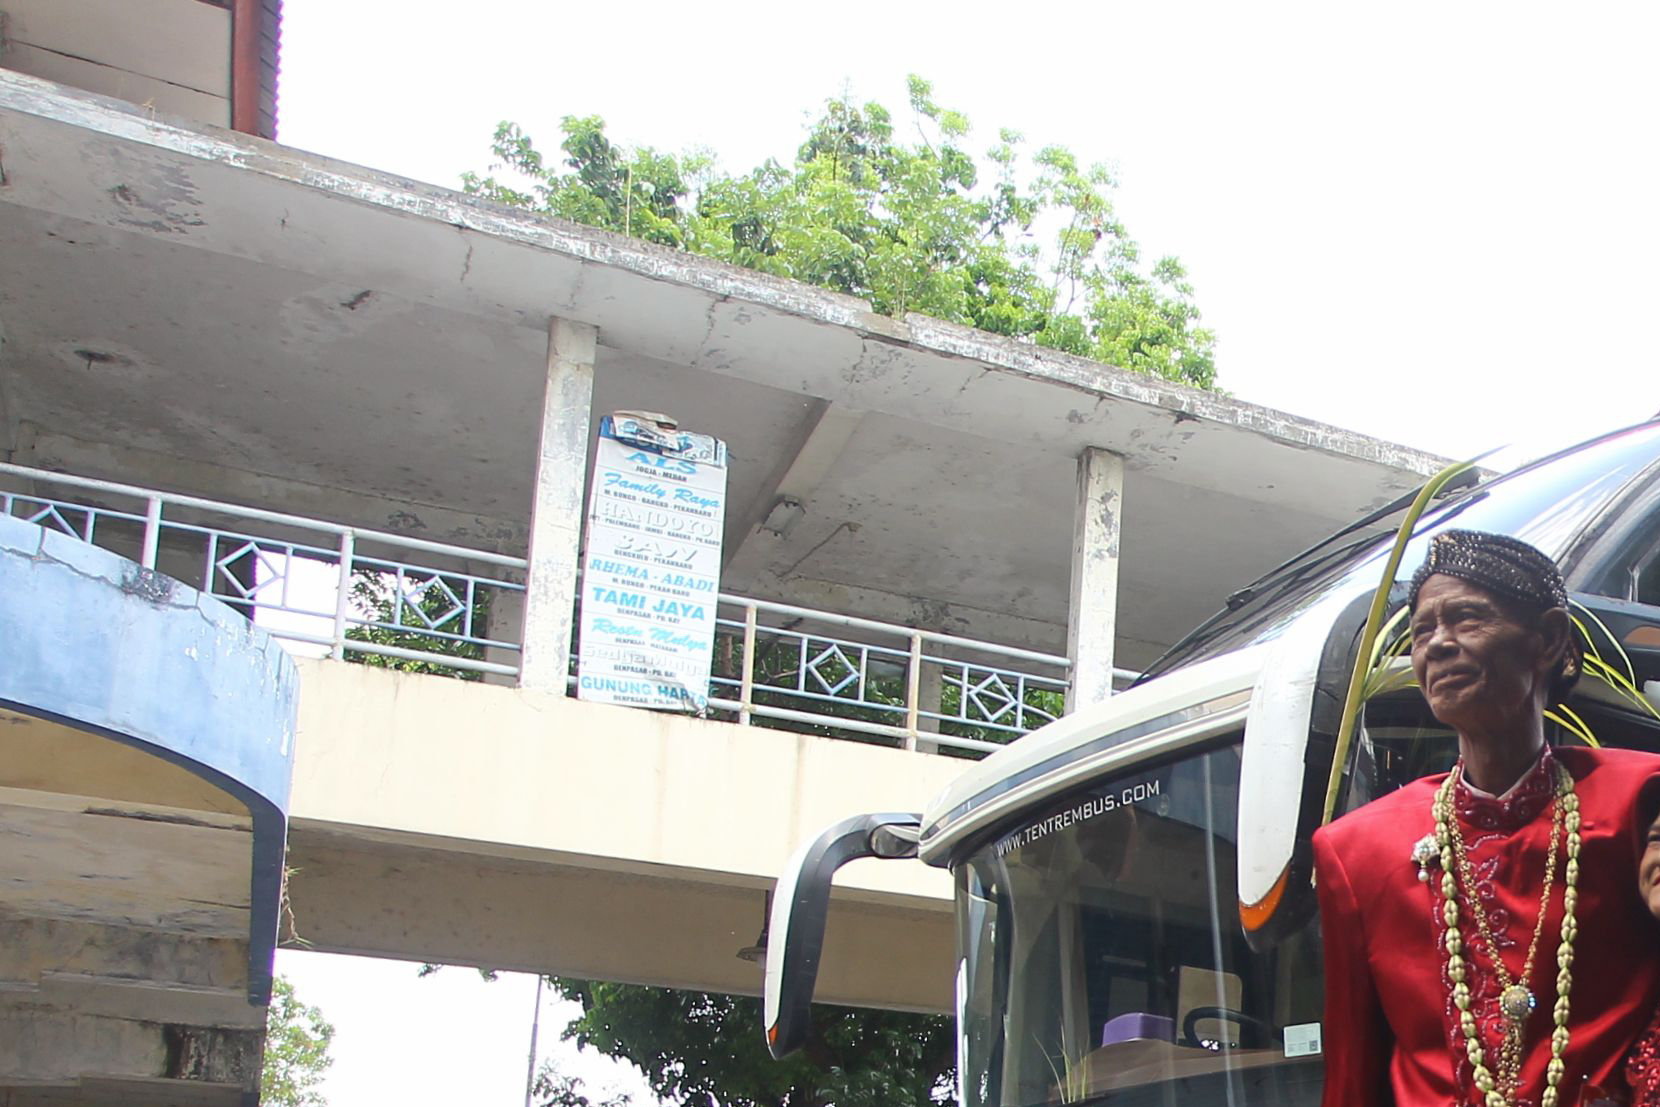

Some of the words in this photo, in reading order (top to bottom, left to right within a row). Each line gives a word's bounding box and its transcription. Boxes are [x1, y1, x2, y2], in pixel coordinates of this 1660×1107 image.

[626, 451, 697, 475] ALS
[604, 471, 666, 498] Family
[673, 487, 721, 509] Raya
[589, 558, 649, 581] RHEMA
[661, 572, 714, 593] ABADI
[592, 586, 647, 610] TAMI
[651, 599, 705, 621] JAYA
[581, 675, 653, 696] GUNUNG
[995, 779, 1160, 856] WWW.TENTREMBUS.COM
